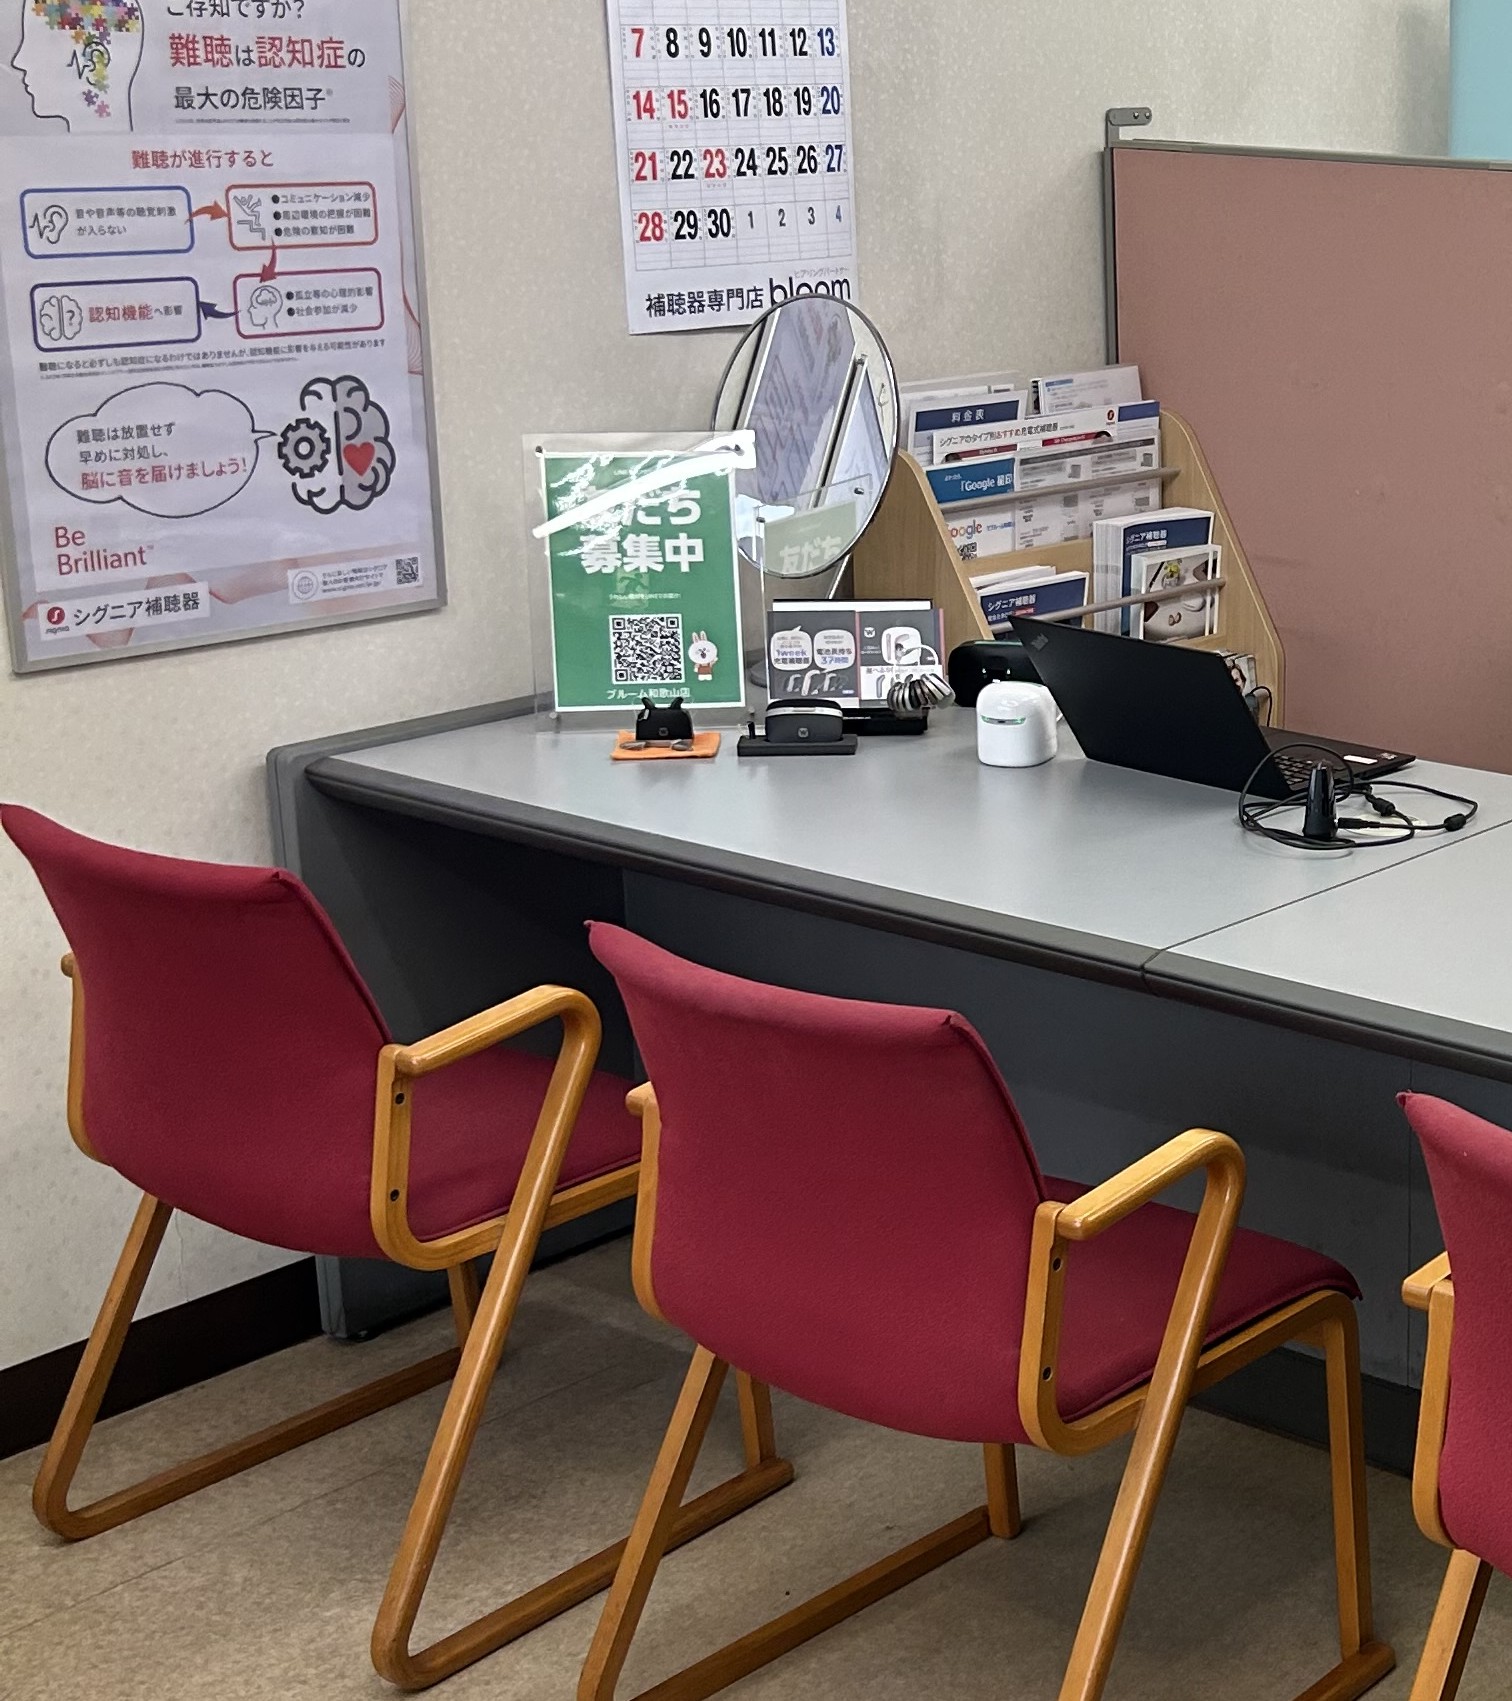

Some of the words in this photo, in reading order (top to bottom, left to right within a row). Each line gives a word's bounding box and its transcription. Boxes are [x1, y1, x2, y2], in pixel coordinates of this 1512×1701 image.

[169, 33, 365, 68] 難聴は認知症の
[631, 28, 644, 58] 7
[666, 27, 680, 58] 8
[699, 27, 712, 57] 9
[727, 27, 747, 57] 10
[758, 27, 777, 57] 11
[789, 27, 808, 56] 12
[817, 27, 835, 57] 13
[632, 90, 655, 120] 14
[667, 89, 689, 119] 15
[700, 88, 720, 118] 16
[732, 88, 751, 117] 17
[763, 87, 783, 117] 18
[793, 86, 812, 116] 19
[821, 86, 840, 115] 20
[132, 150, 273, 169] 難聴が進行すると
[634, 151, 658, 181] 21
[670, 150, 695, 180] 22
[703, 149, 727, 179] 23
[734, 148, 758, 177] 24
[765, 147, 788, 175] 25
[797, 145, 818, 174] 26
[825, 144, 843, 173] 27
[637, 211, 665, 242] 28
[673, 210, 699, 240] 29
[707, 208, 731, 238] 30
[747, 211, 754, 229] 1
[779, 208, 786, 227] 2
[808, 207, 815, 225] 3
[835, 205, 842, 223] 4
[646, 286, 764, 318] 補聴器専門店
[77, 422, 176, 444] 難聴は放置せず
[79, 445, 169, 464] 早めに対処し、
[55, 526, 86, 548] Be
[579, 532, 704, 574] 募集中
[57, 546, 148, 576] Brilliant
[74, 591, 200, 626] シグニア補聴器
